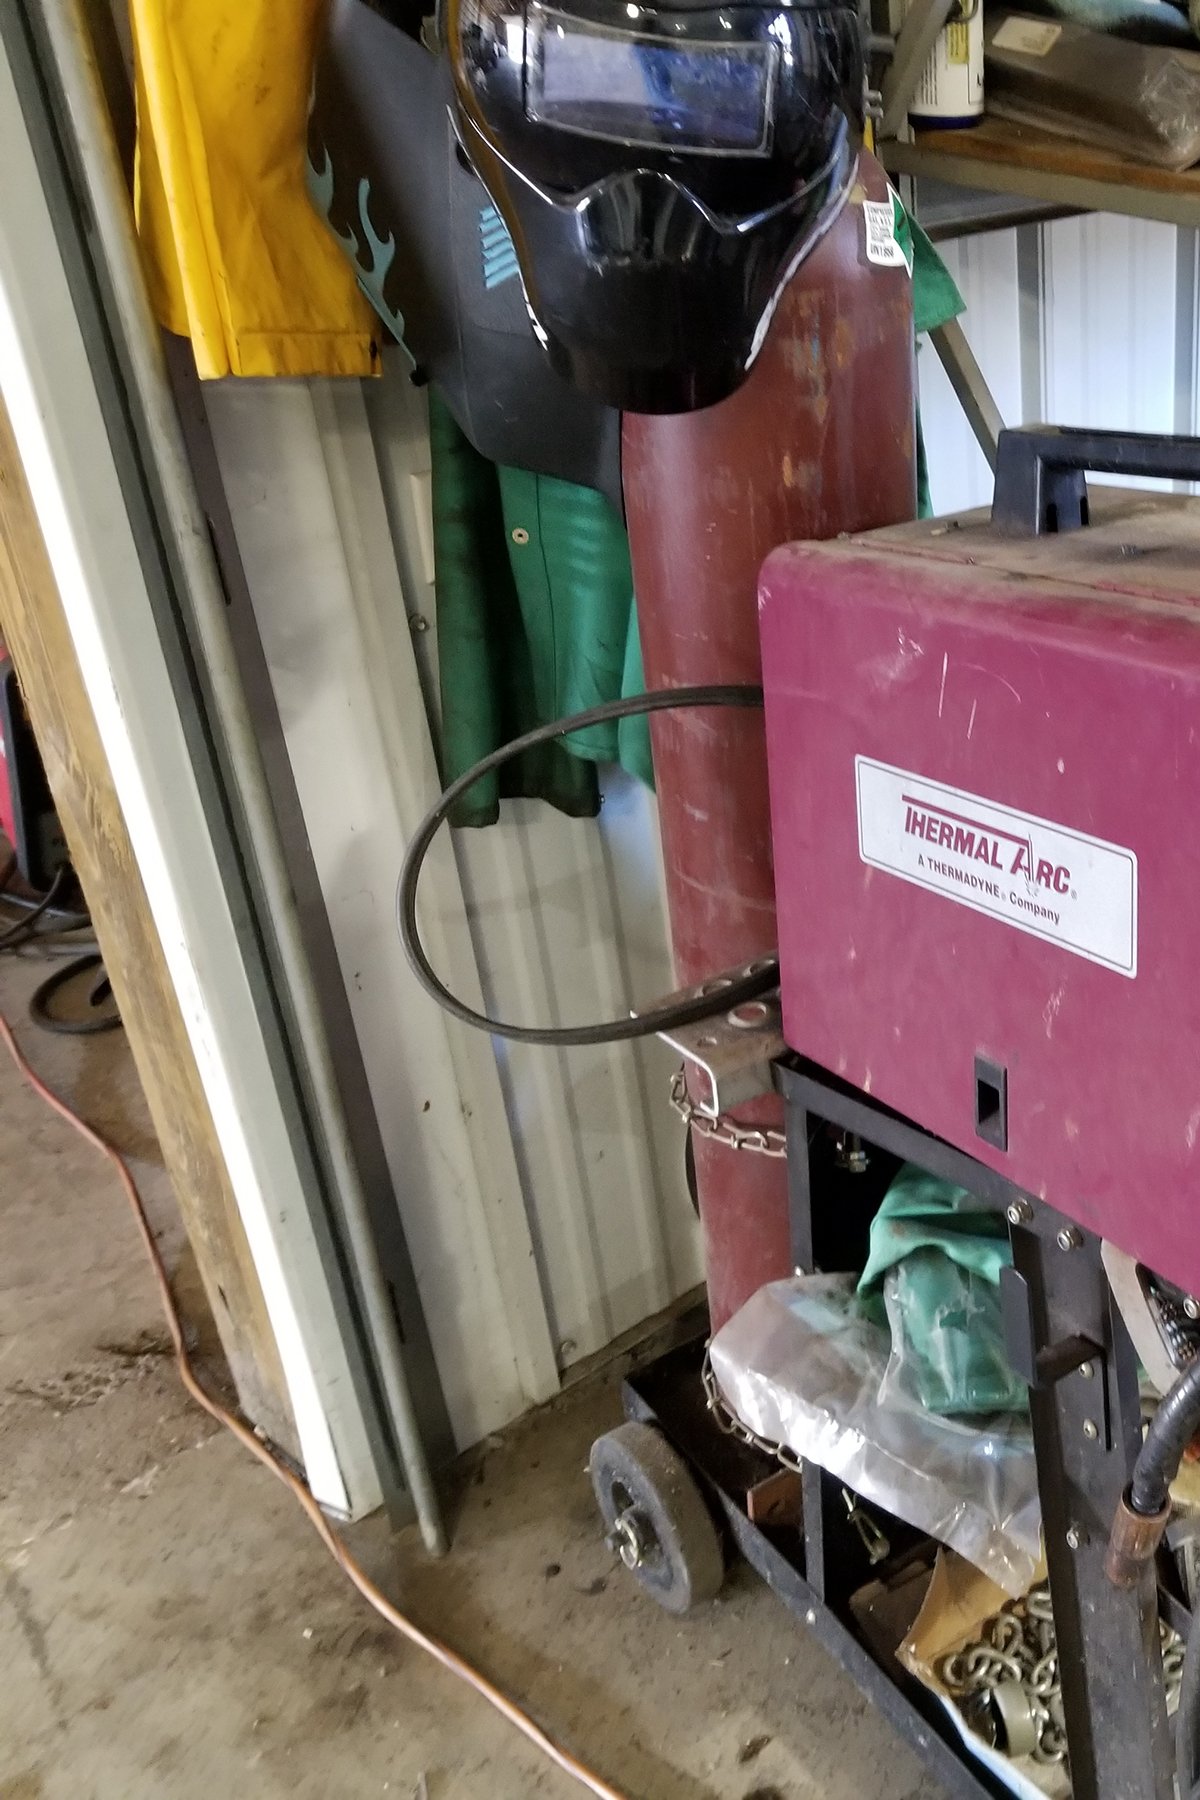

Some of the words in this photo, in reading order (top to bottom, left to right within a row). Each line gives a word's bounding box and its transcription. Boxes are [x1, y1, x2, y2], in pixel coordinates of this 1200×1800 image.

[901, 794, 1004, 871] THERMAL
[918, 854, 925, 868] A
[928, 857, 1001, 899] THERMADYNE
[1009, 891, 1061, 926] Company
